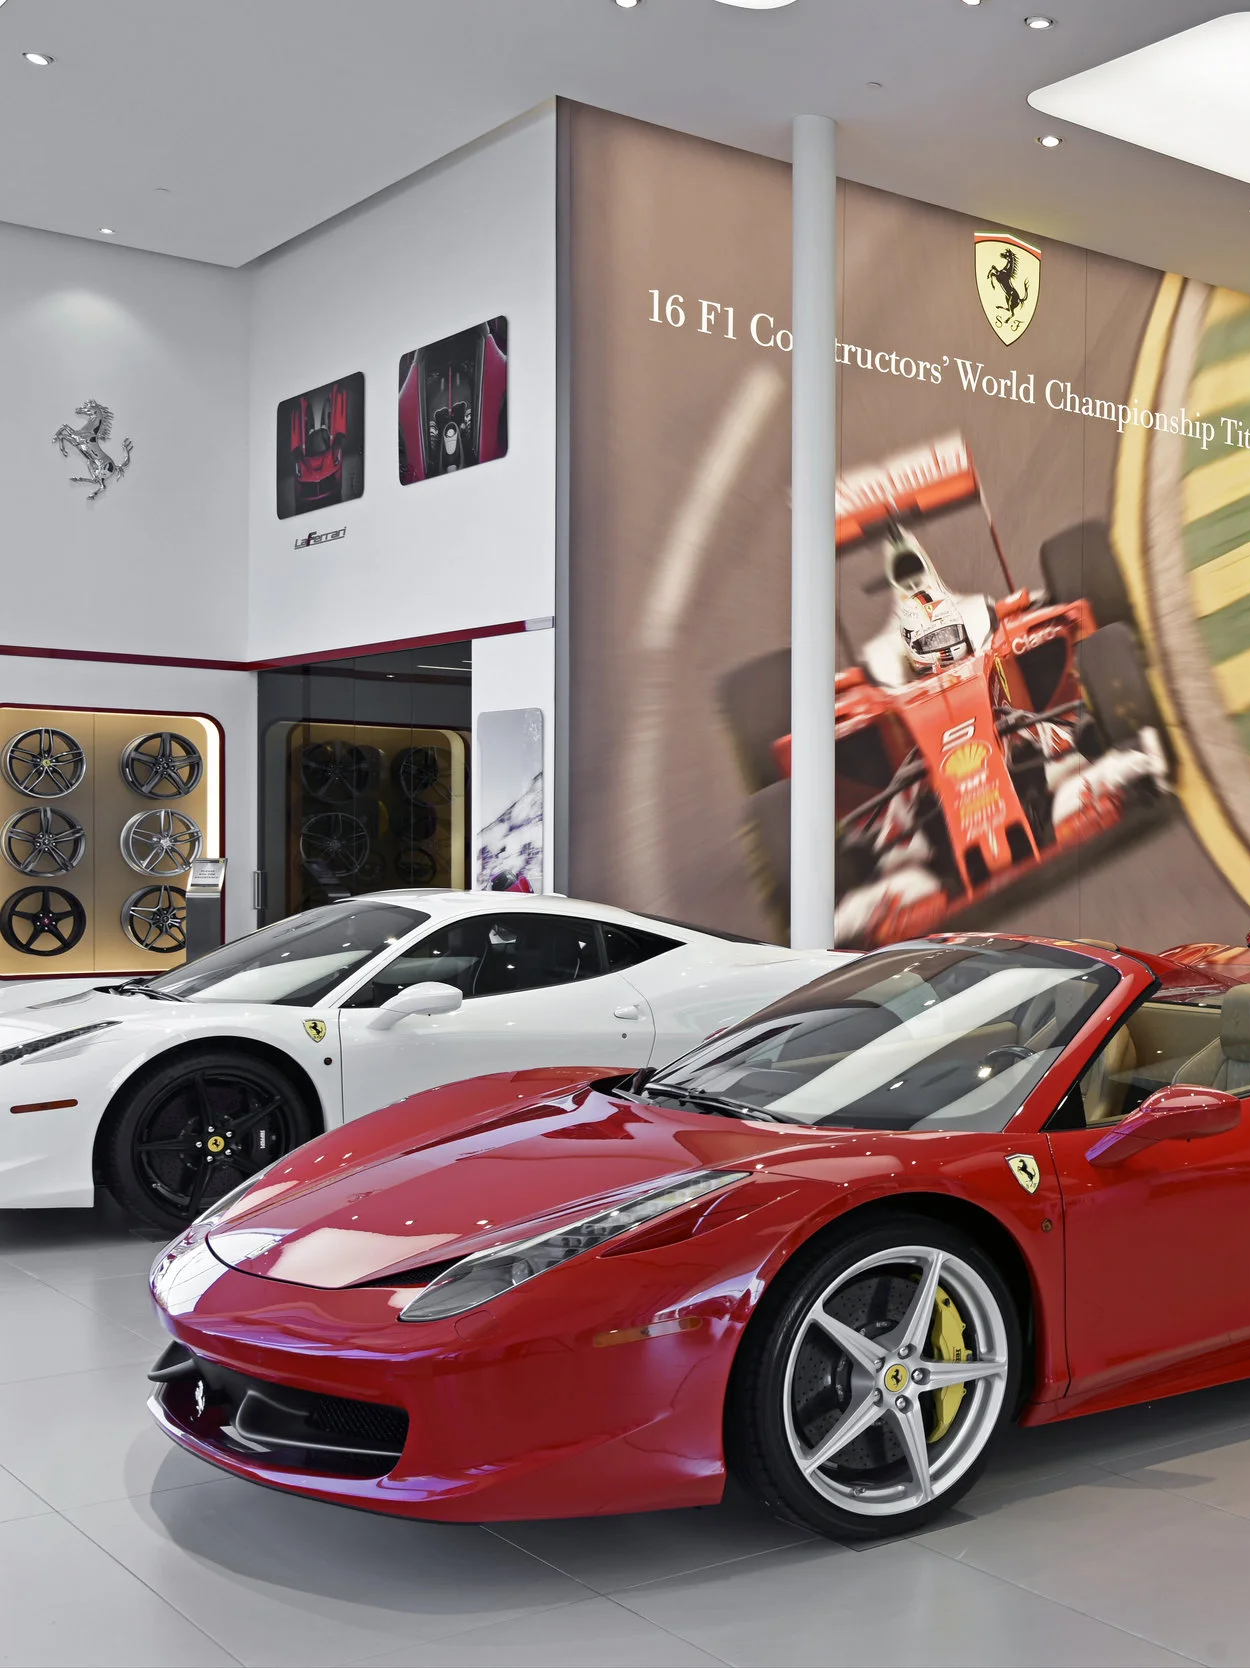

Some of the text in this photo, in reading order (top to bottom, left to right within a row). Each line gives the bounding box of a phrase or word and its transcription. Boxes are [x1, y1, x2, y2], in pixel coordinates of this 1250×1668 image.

[994, 315, 1003, 328] S
[648, 289, 686, 327] 16
[697, 299, 737, 340] F1
[750, 313, 950, 385] Cotructors’
[953, 357, 1036, 404] World
[1045, 379, 1216, 451] Championship
[294, 526, 347, 550] LaFerrari
[941, 716, 977, 753] 5
